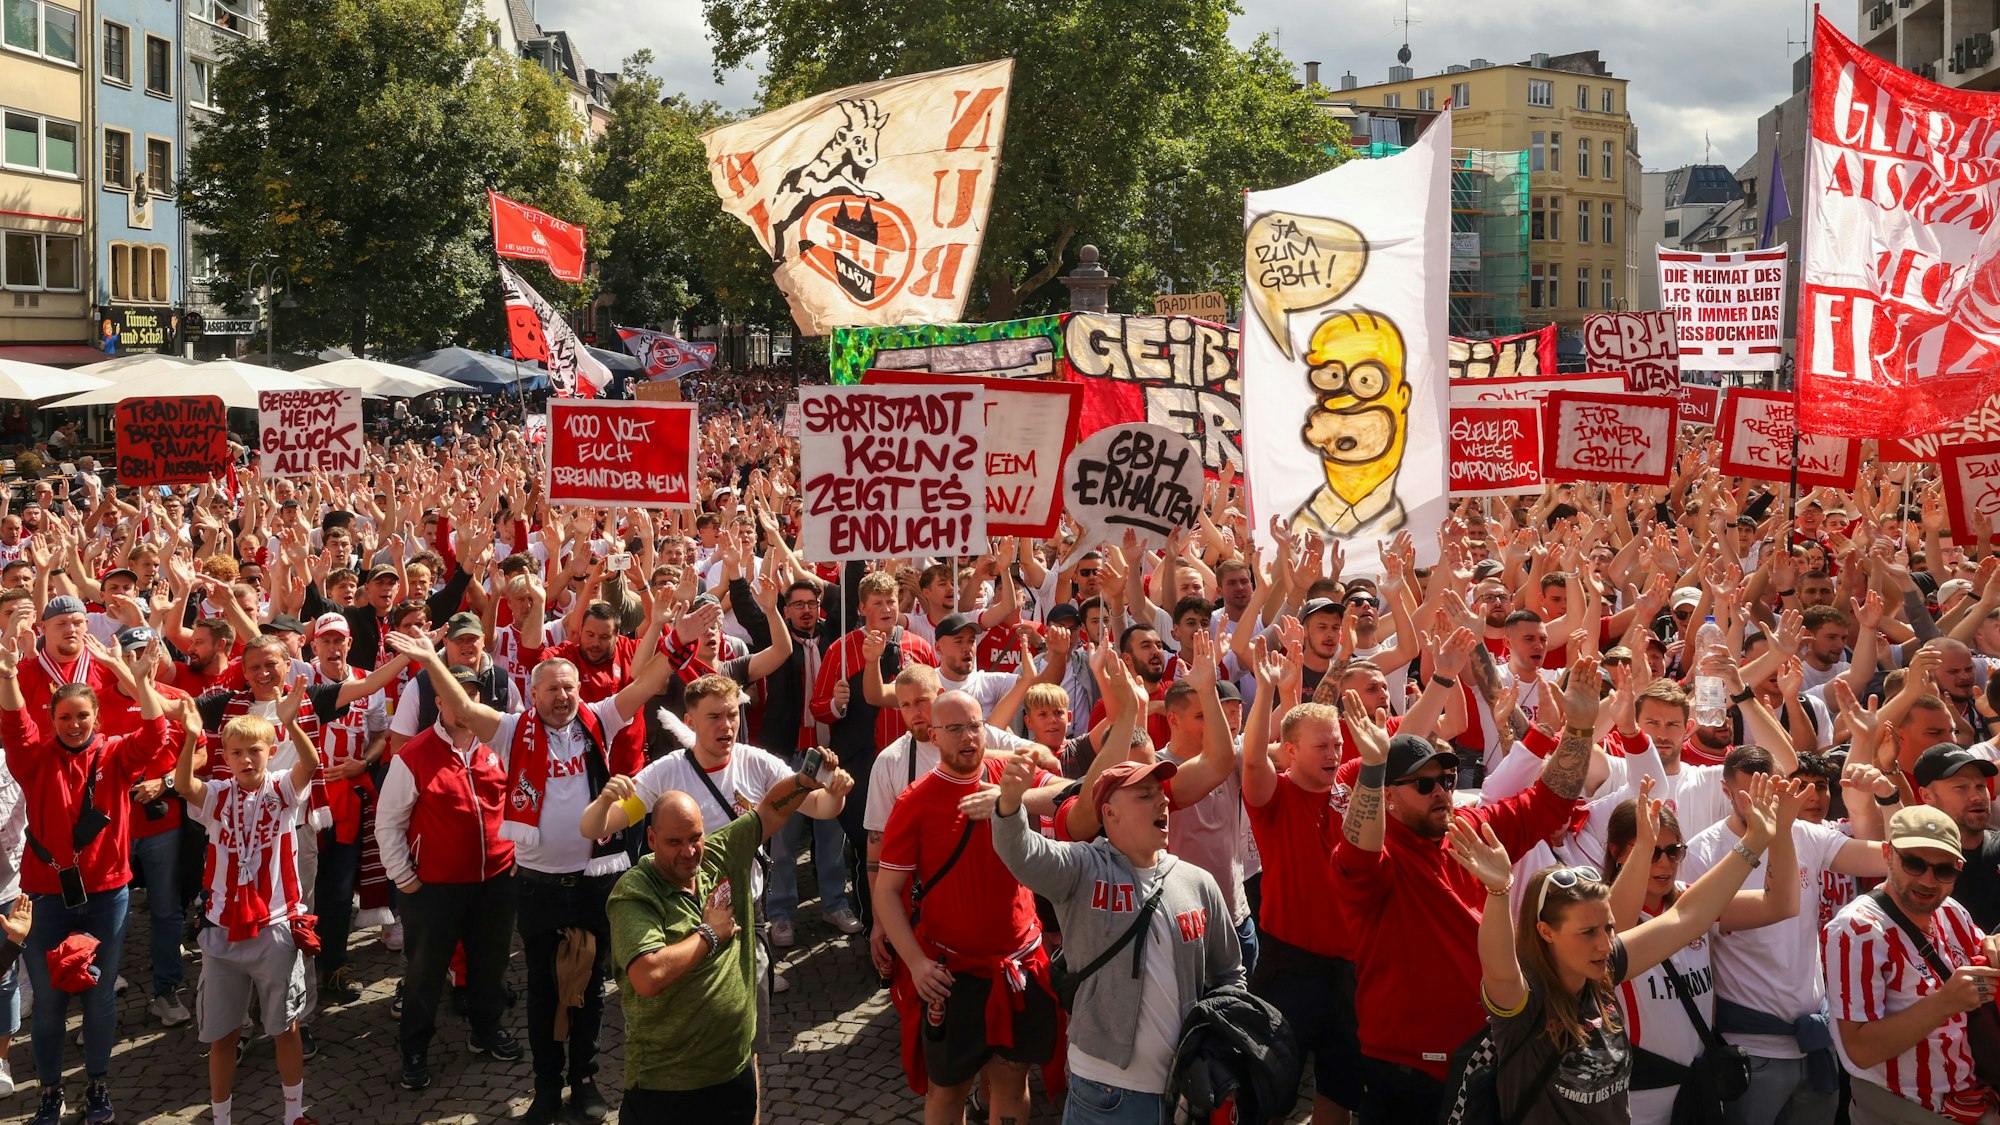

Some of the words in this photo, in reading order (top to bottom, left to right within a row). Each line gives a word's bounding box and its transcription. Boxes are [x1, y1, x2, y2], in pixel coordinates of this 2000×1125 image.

[1255, 236, 1320, 264] ZUM
[1664, 268, 1688, 283] DIE
[1693, 269, 1749, 285] HEIMAT
[1754, 268, 1782, 283] DES
[1156, 294, 1222, 315] TRADITION
[1663, 288, 1691, 303] 1.FC
[1696, 286, 1732, 303] KÖLN
[1736, 287, 1781, 303] BLEIBT
[124, 310, 158, 328] Tünnes
[1698, 307, 1748, 322] IMMER
[1751, 305, 1780, 321] DAS
[120, 329, 139, 345] und
[140, 328, 164, 345] Schäl
[1583, 311, 1679, 364] GBH
[1677, 324, 1778, 341] EISSBOCKHEI
[121, 398, 224, 425] TRADITION
[280, 407, 336, 428] HEIM
[803, 391, 974, 436] SPORTSTADT
[1575, 406, 1624, 426] FÜR
[1678, 401, 1709, 418] TEN!
[1765, 404, 1795, 422] HIE
[122, 424, 227, 445] BRAUCHT
[262, 422, 357, 454] GLÜCK
[563, 413, 600, 439] 1000
[606, 415, 656, 444] VOLT
[274, 447, 361, 474] ALLEIN
[577, 442, 633, 463] EUCH
[1107, 430, 1190, 481] GBH
[1460, 442, 1513, 461] WIESE
[1748, 446, 1770, 465] FC
[1775, 450, 1840, 473] KLN!
[120, 456, 157, 479] GBH
[162, 456, 227, 477] AUSBAUEN
[645, 471, 687, 495] HELM
[805, 473, 916, 516] ZEIGT
[920, 479, 972, 513] ES
[1072, 459, 1202, 530] ERHALTEN
[830, 513, 972, 555] ENDLICH!
[1090, 880, 1135, 913] ULT
[1553, 1082, 1594, 1105] EIMAT
[1595, 1087, 1610, 1103] DES
